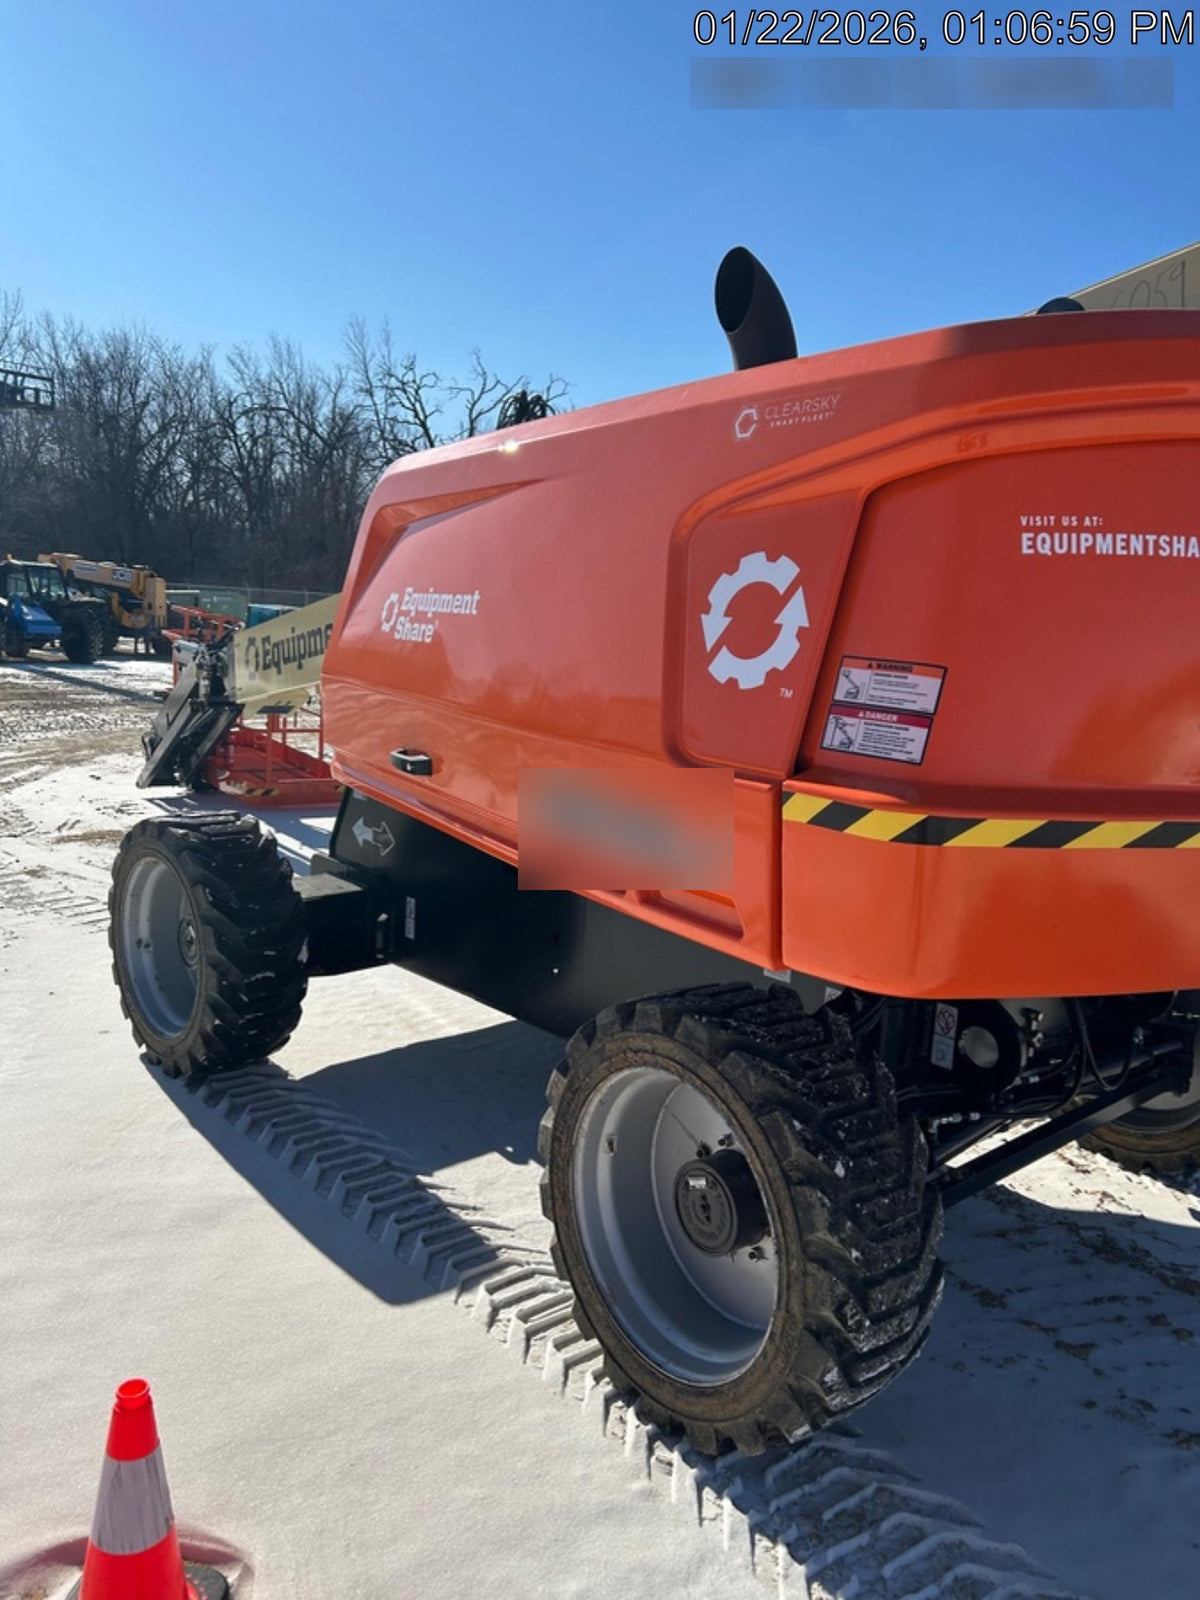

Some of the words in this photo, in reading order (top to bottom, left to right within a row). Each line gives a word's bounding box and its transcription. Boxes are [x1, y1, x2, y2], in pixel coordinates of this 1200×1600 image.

[764, 395, 840, 419] CLEARSKY
[1020, 515, 1056, 527] VISIT
[1061, 516, 1079, 527] US
[1083, 516, 1104, 527] AT:
[1021, 532, 1200, 558] EQUIPMENTSHA
[400, 586, 481, 618] Equipment
[394, 615, 434, 643] Share
[779, 687, 794, 698] TM
[865, 711, 898, 722] DANGER
